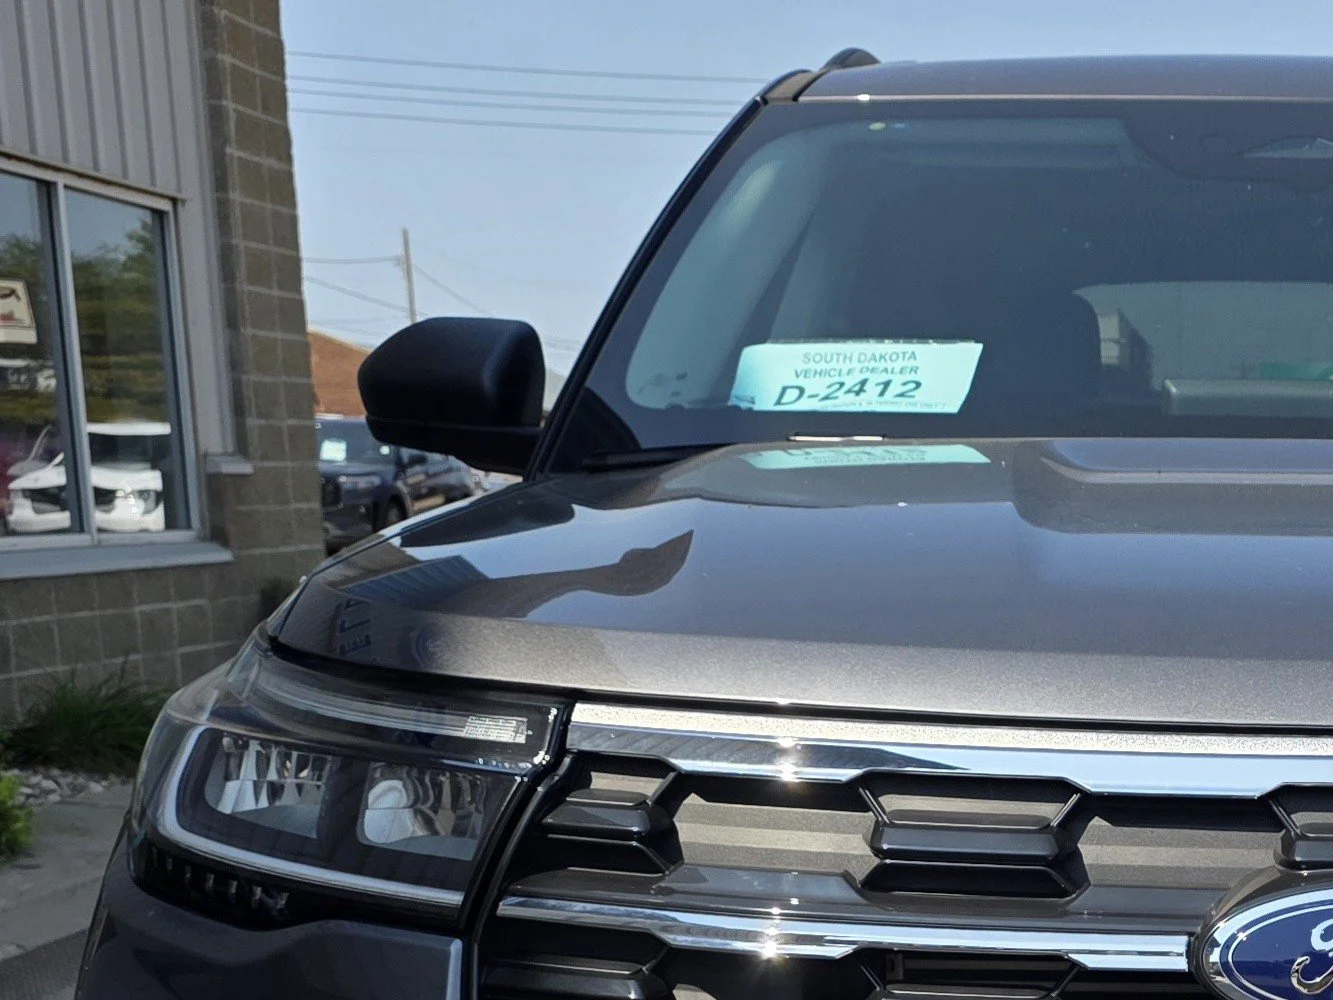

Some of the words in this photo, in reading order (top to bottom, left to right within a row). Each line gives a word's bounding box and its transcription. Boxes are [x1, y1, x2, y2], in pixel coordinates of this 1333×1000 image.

[802, 351, 853, 364] SOUTH
[857, 350, 917, 363] DAKOTA
[794, 367, 856, 379] VEHICLE
[859, 365, 919, 376] DEALER
[773, 377, 922, 406] D-2412
